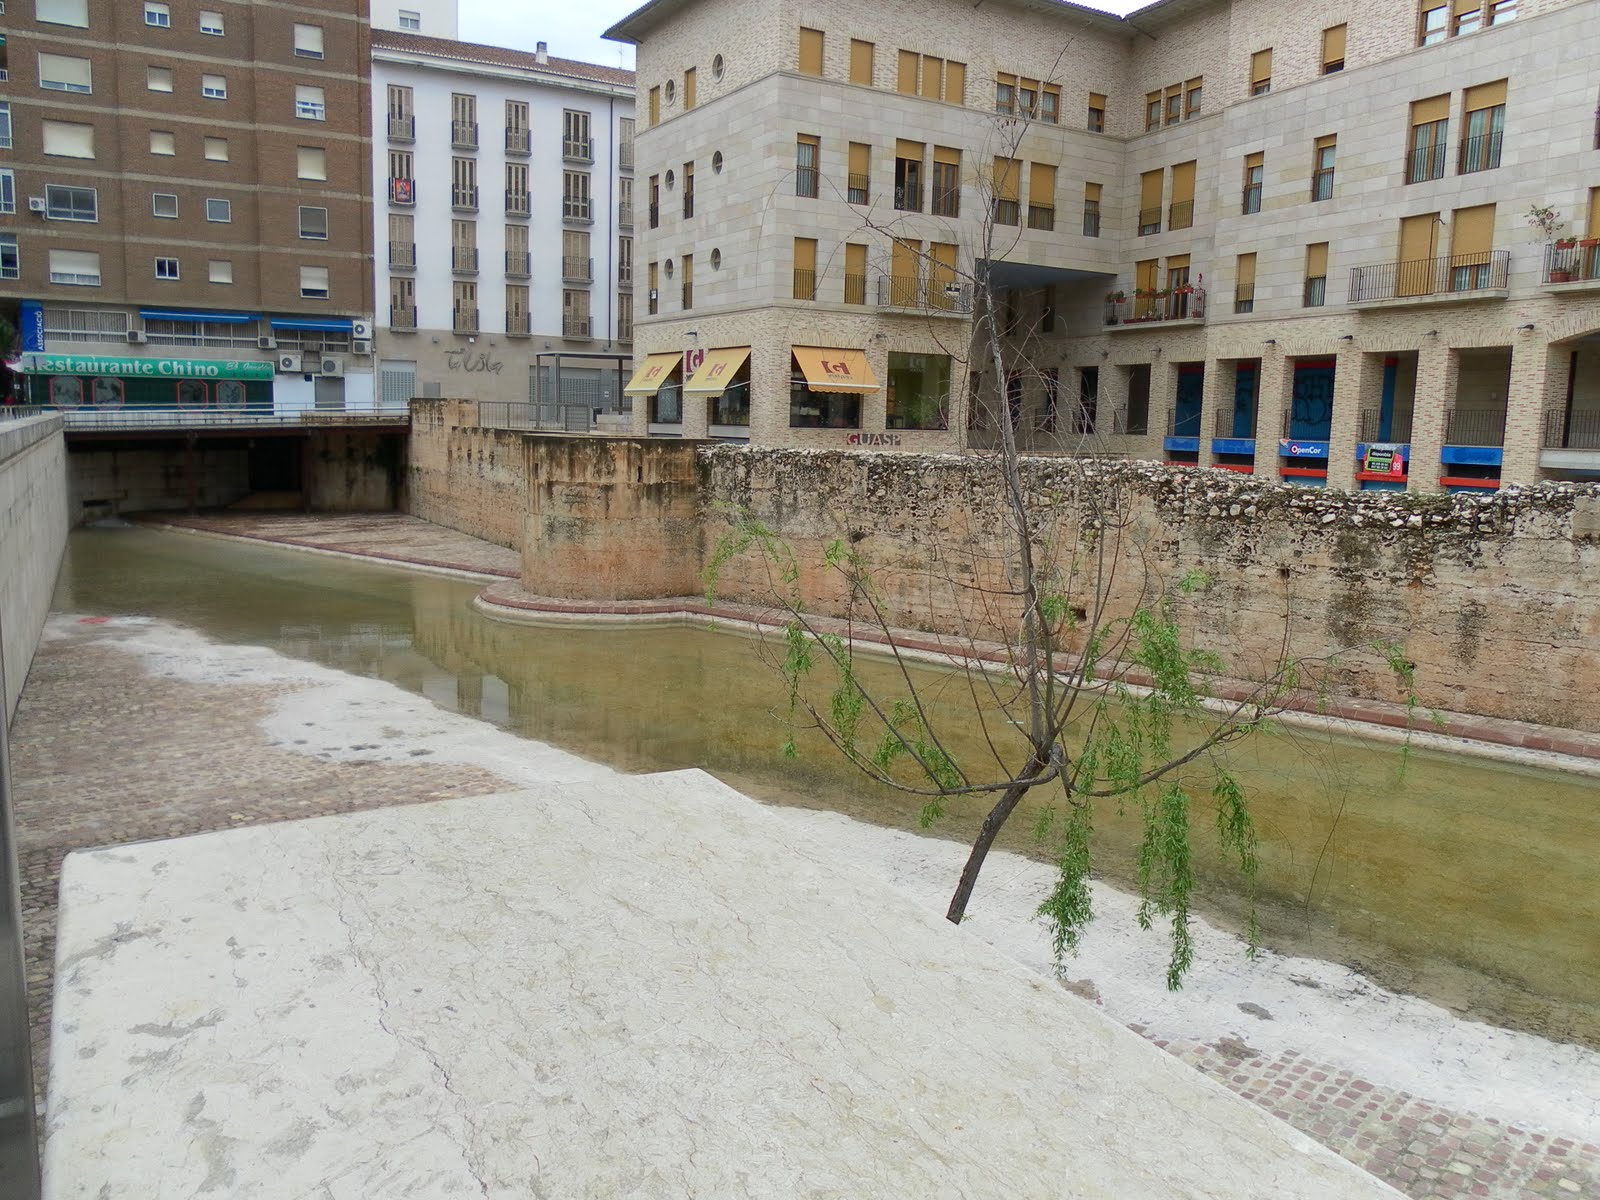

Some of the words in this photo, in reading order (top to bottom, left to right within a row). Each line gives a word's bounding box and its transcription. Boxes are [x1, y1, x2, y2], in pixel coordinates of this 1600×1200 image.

[158, 361, 218, 377] Chino
[847, 433, 901, 446] GUASP
[1290, 445, 1322, 455] OpenCor
